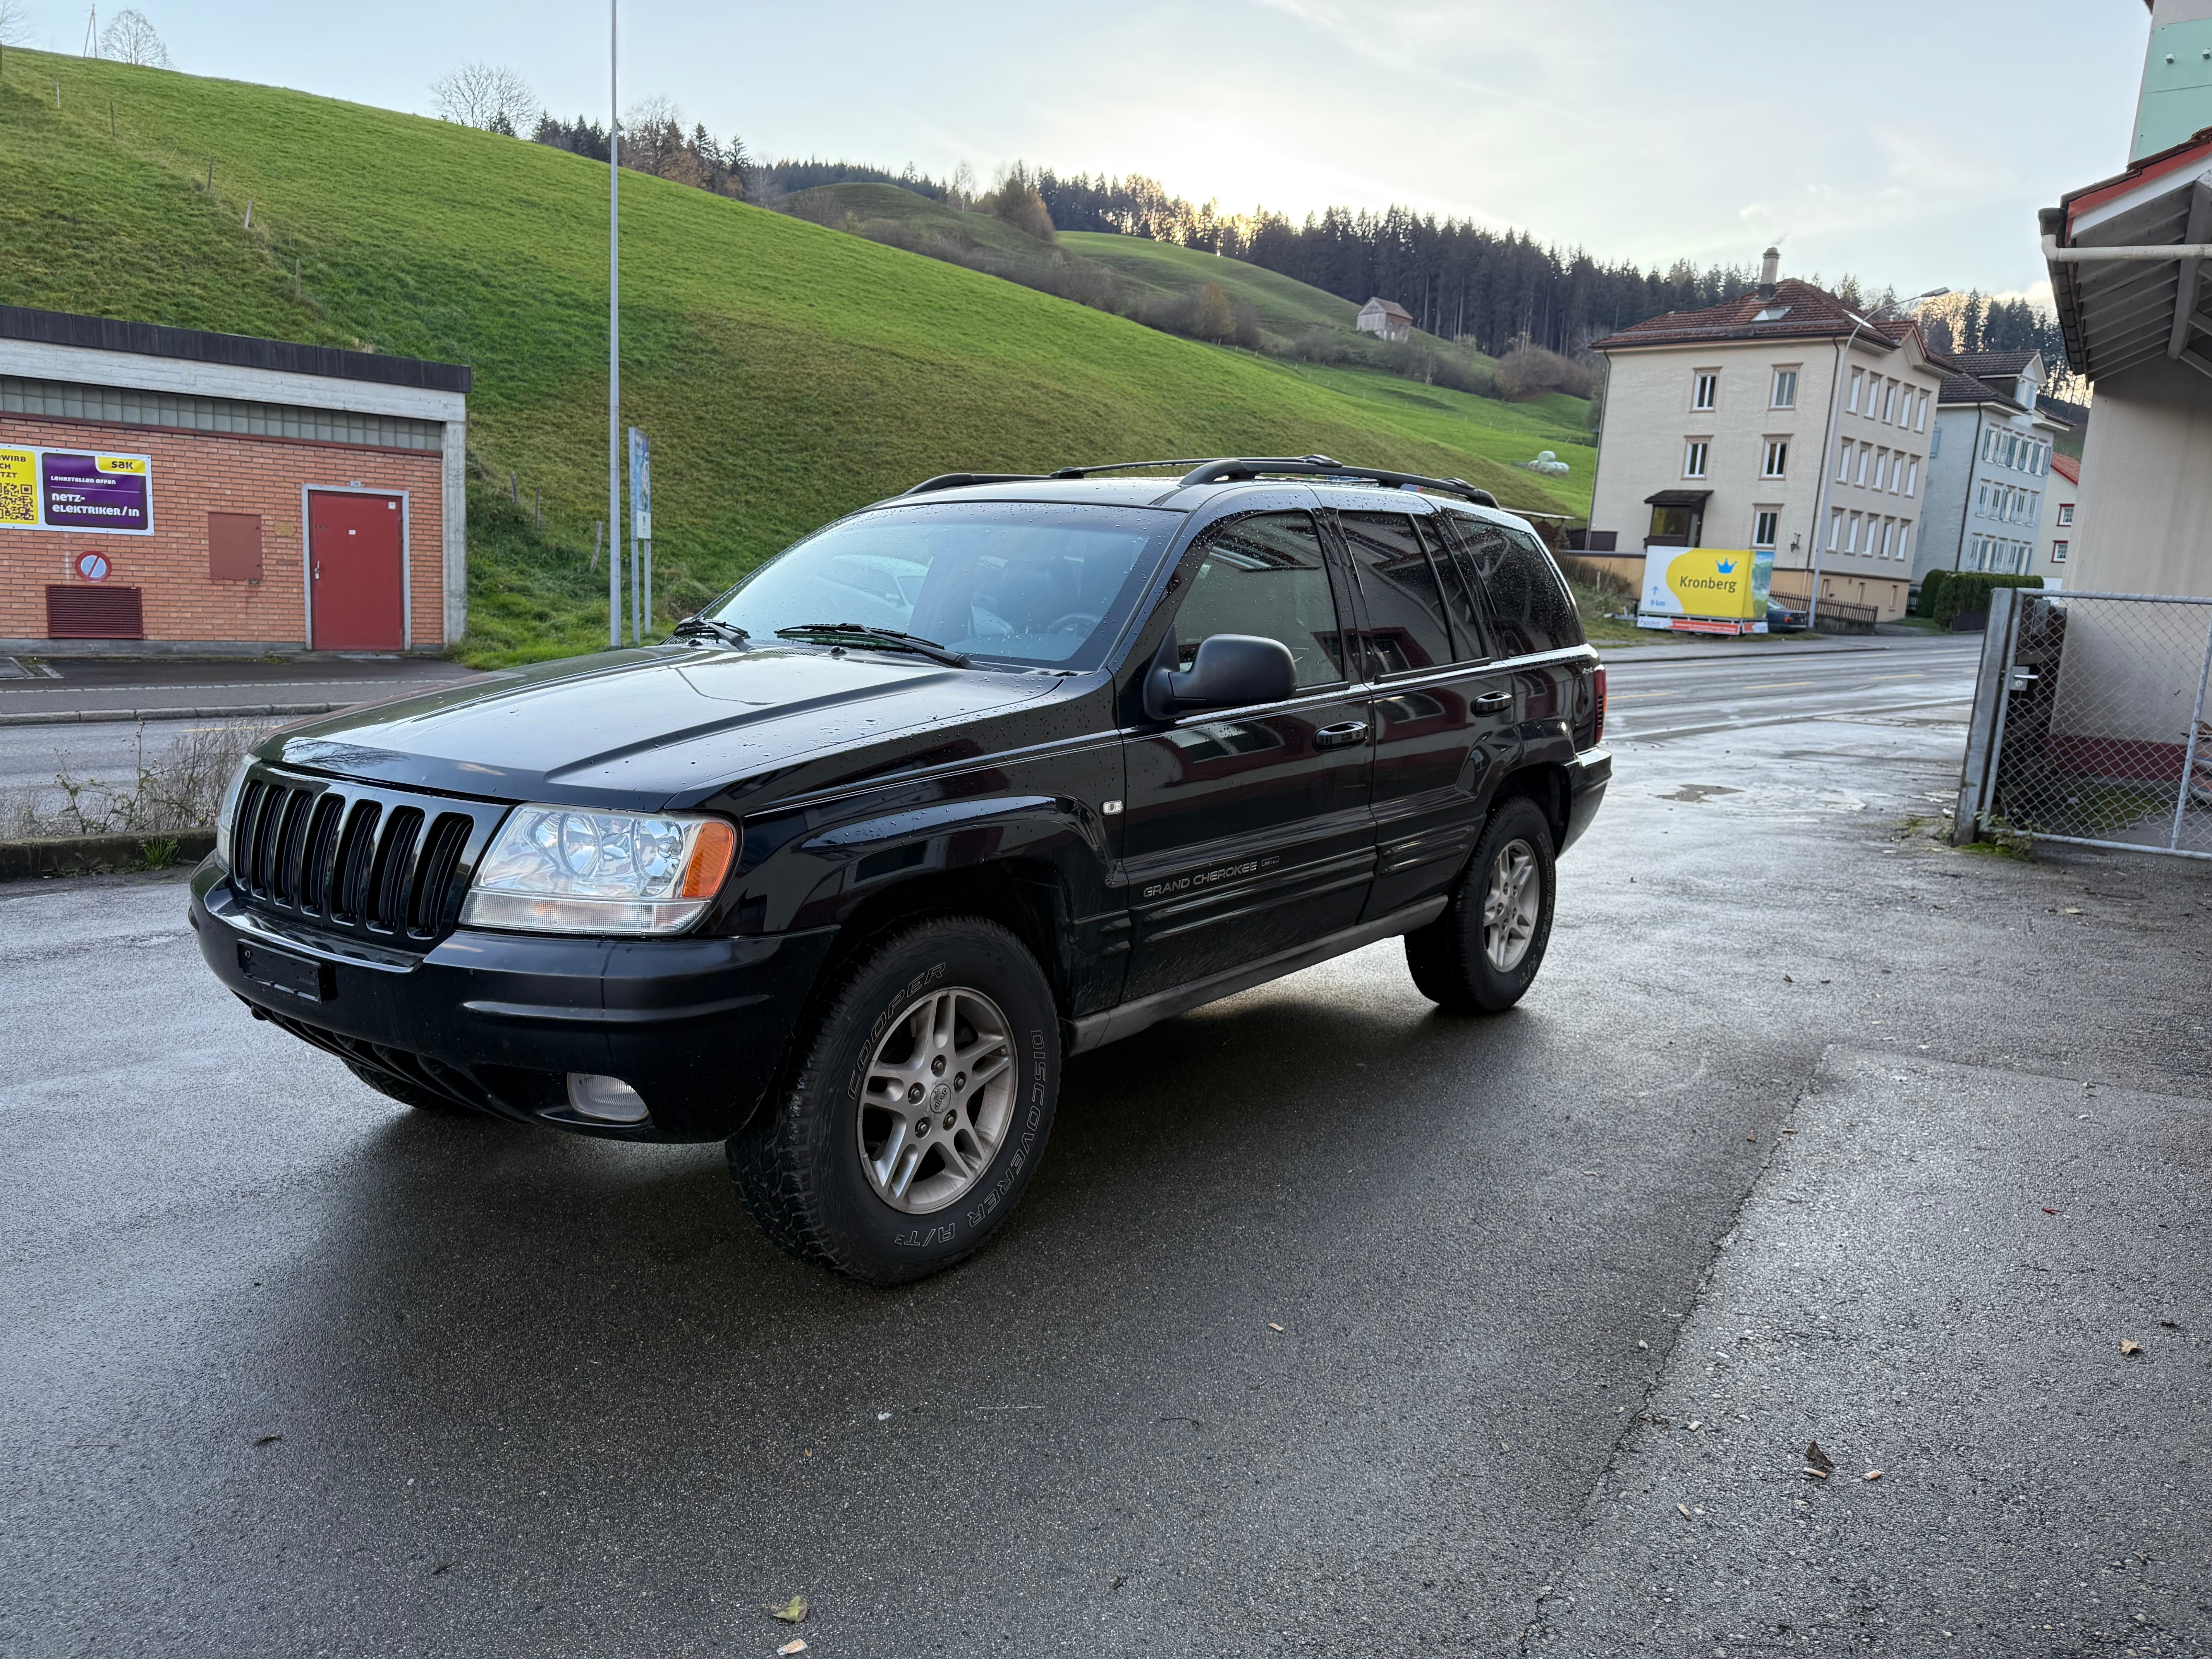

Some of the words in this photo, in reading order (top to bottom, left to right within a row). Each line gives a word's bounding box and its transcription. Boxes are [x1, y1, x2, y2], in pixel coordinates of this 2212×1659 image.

[1680, 576, 1737, 593] Kronberg
[1144, 878, 1190, 897] GRAND
[1194, 862, 1257, 885] CHEROKEE
[848, 962, 946, 1100] COOPER
[935, 1087, 948, 1110] Jeep
[967, 1030, 1046, 1227] DISCOVERER
